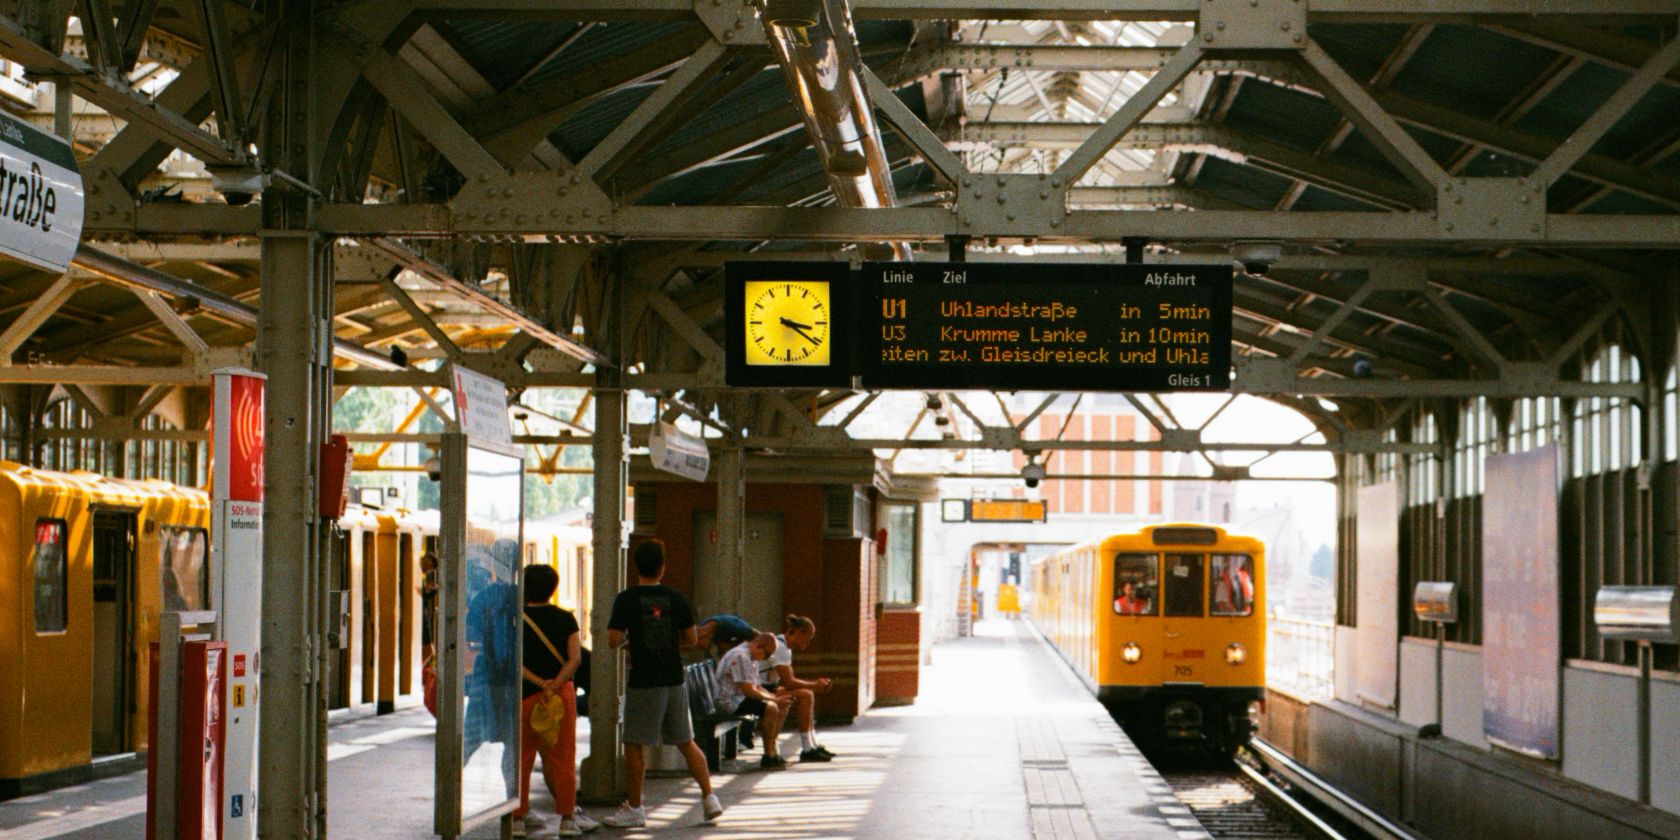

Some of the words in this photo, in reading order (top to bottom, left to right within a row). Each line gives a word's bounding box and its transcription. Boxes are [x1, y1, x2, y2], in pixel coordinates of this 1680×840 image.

[883, 271, 914, 283] Linie
[943, 271, 967, 283] Ziel
[1144, 273, 1196, 286] Abfahrt
[882, 299, 906, 318] U1
[941, 301, 1078, 322] Uhlandstraße
[1120, 303, 1141, 319] in
[1159, 303, 1210, 319] 5min
[882, 325, 906, 341] U3
[941, 326, 1020, 342] Krumme
[1030, 326, 1088, 343] Lanke
[1120, 327, 1141, 343] in
[1148, 327, 1210, 343] 10min
[939, 350, 972, 362] zw.
[981, 346, 1109, 363] Gleisdreieck
[1119, 348, 1157, 363] und
[1168, 373, 1200, 387] Gleis
[1205, 374, 1211, 386] 1
[234, 661, 245, 671] SOS
[1173, 665, 1193, 676] 705
